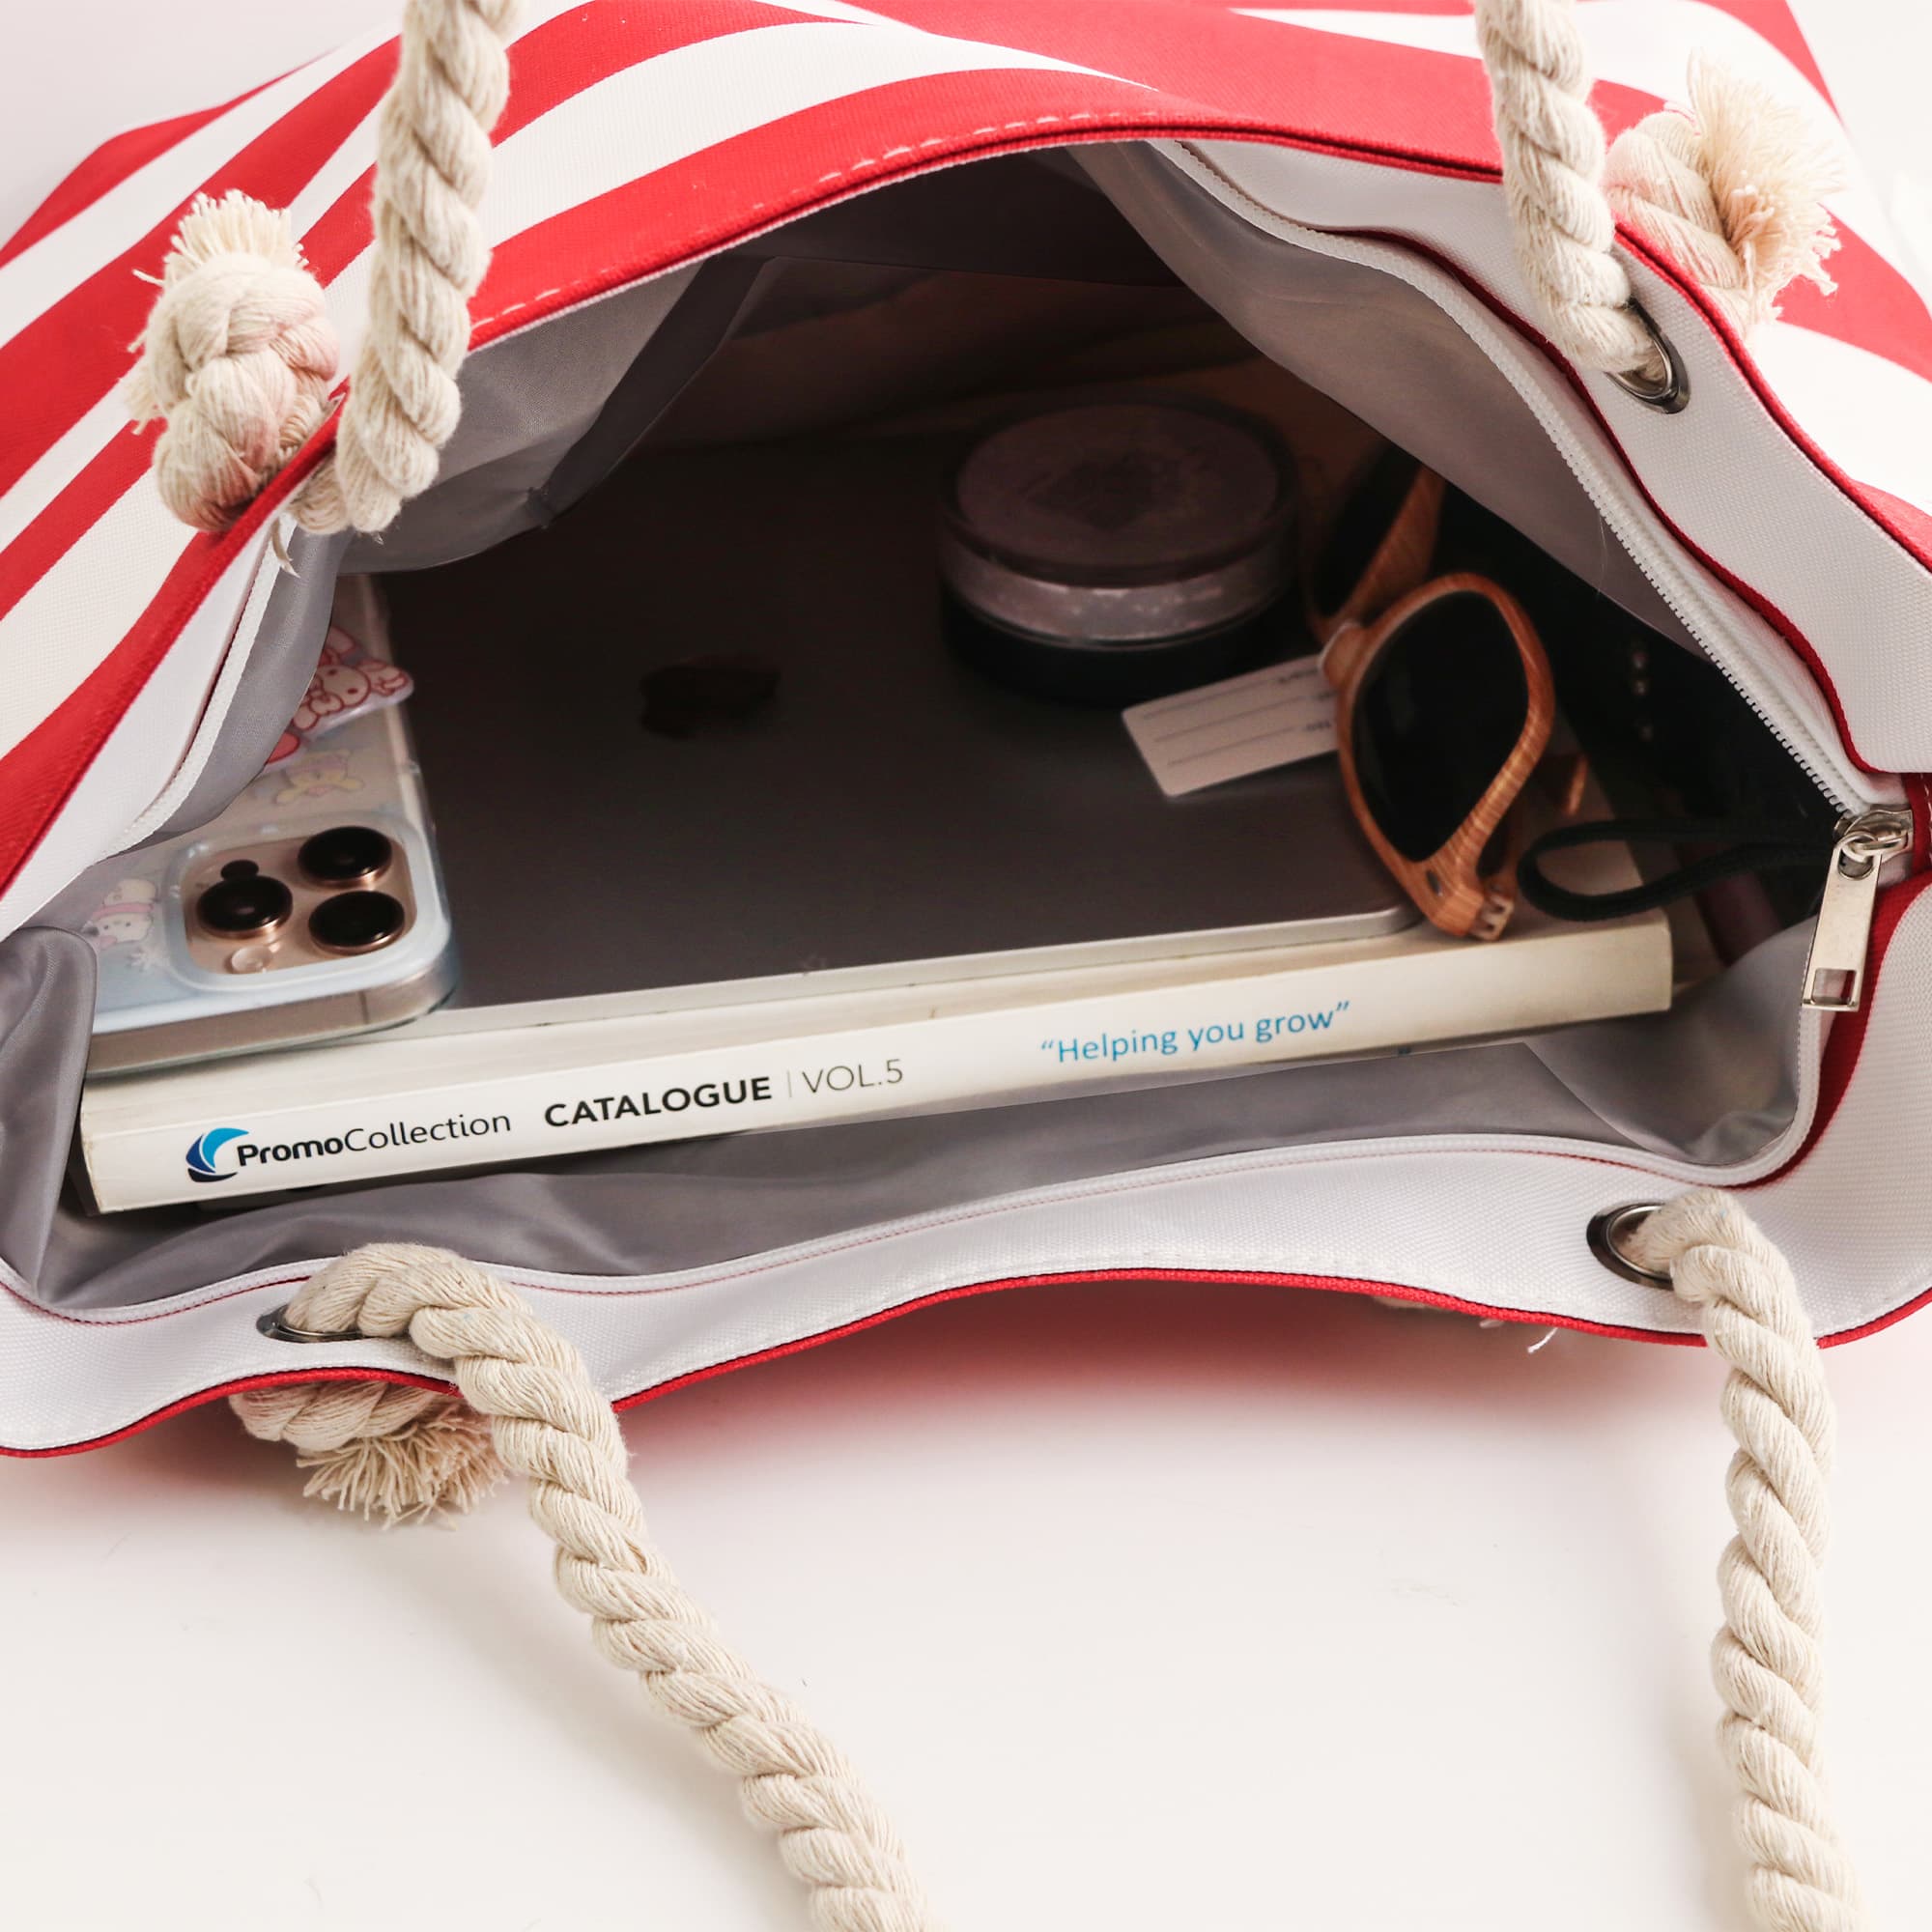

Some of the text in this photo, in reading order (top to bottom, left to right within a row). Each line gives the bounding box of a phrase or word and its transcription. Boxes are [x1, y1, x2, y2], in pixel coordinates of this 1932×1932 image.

[237, 1001, 1350, 1168] PromoCollection CATALOGUE VOL.5 “Helping you grow”
